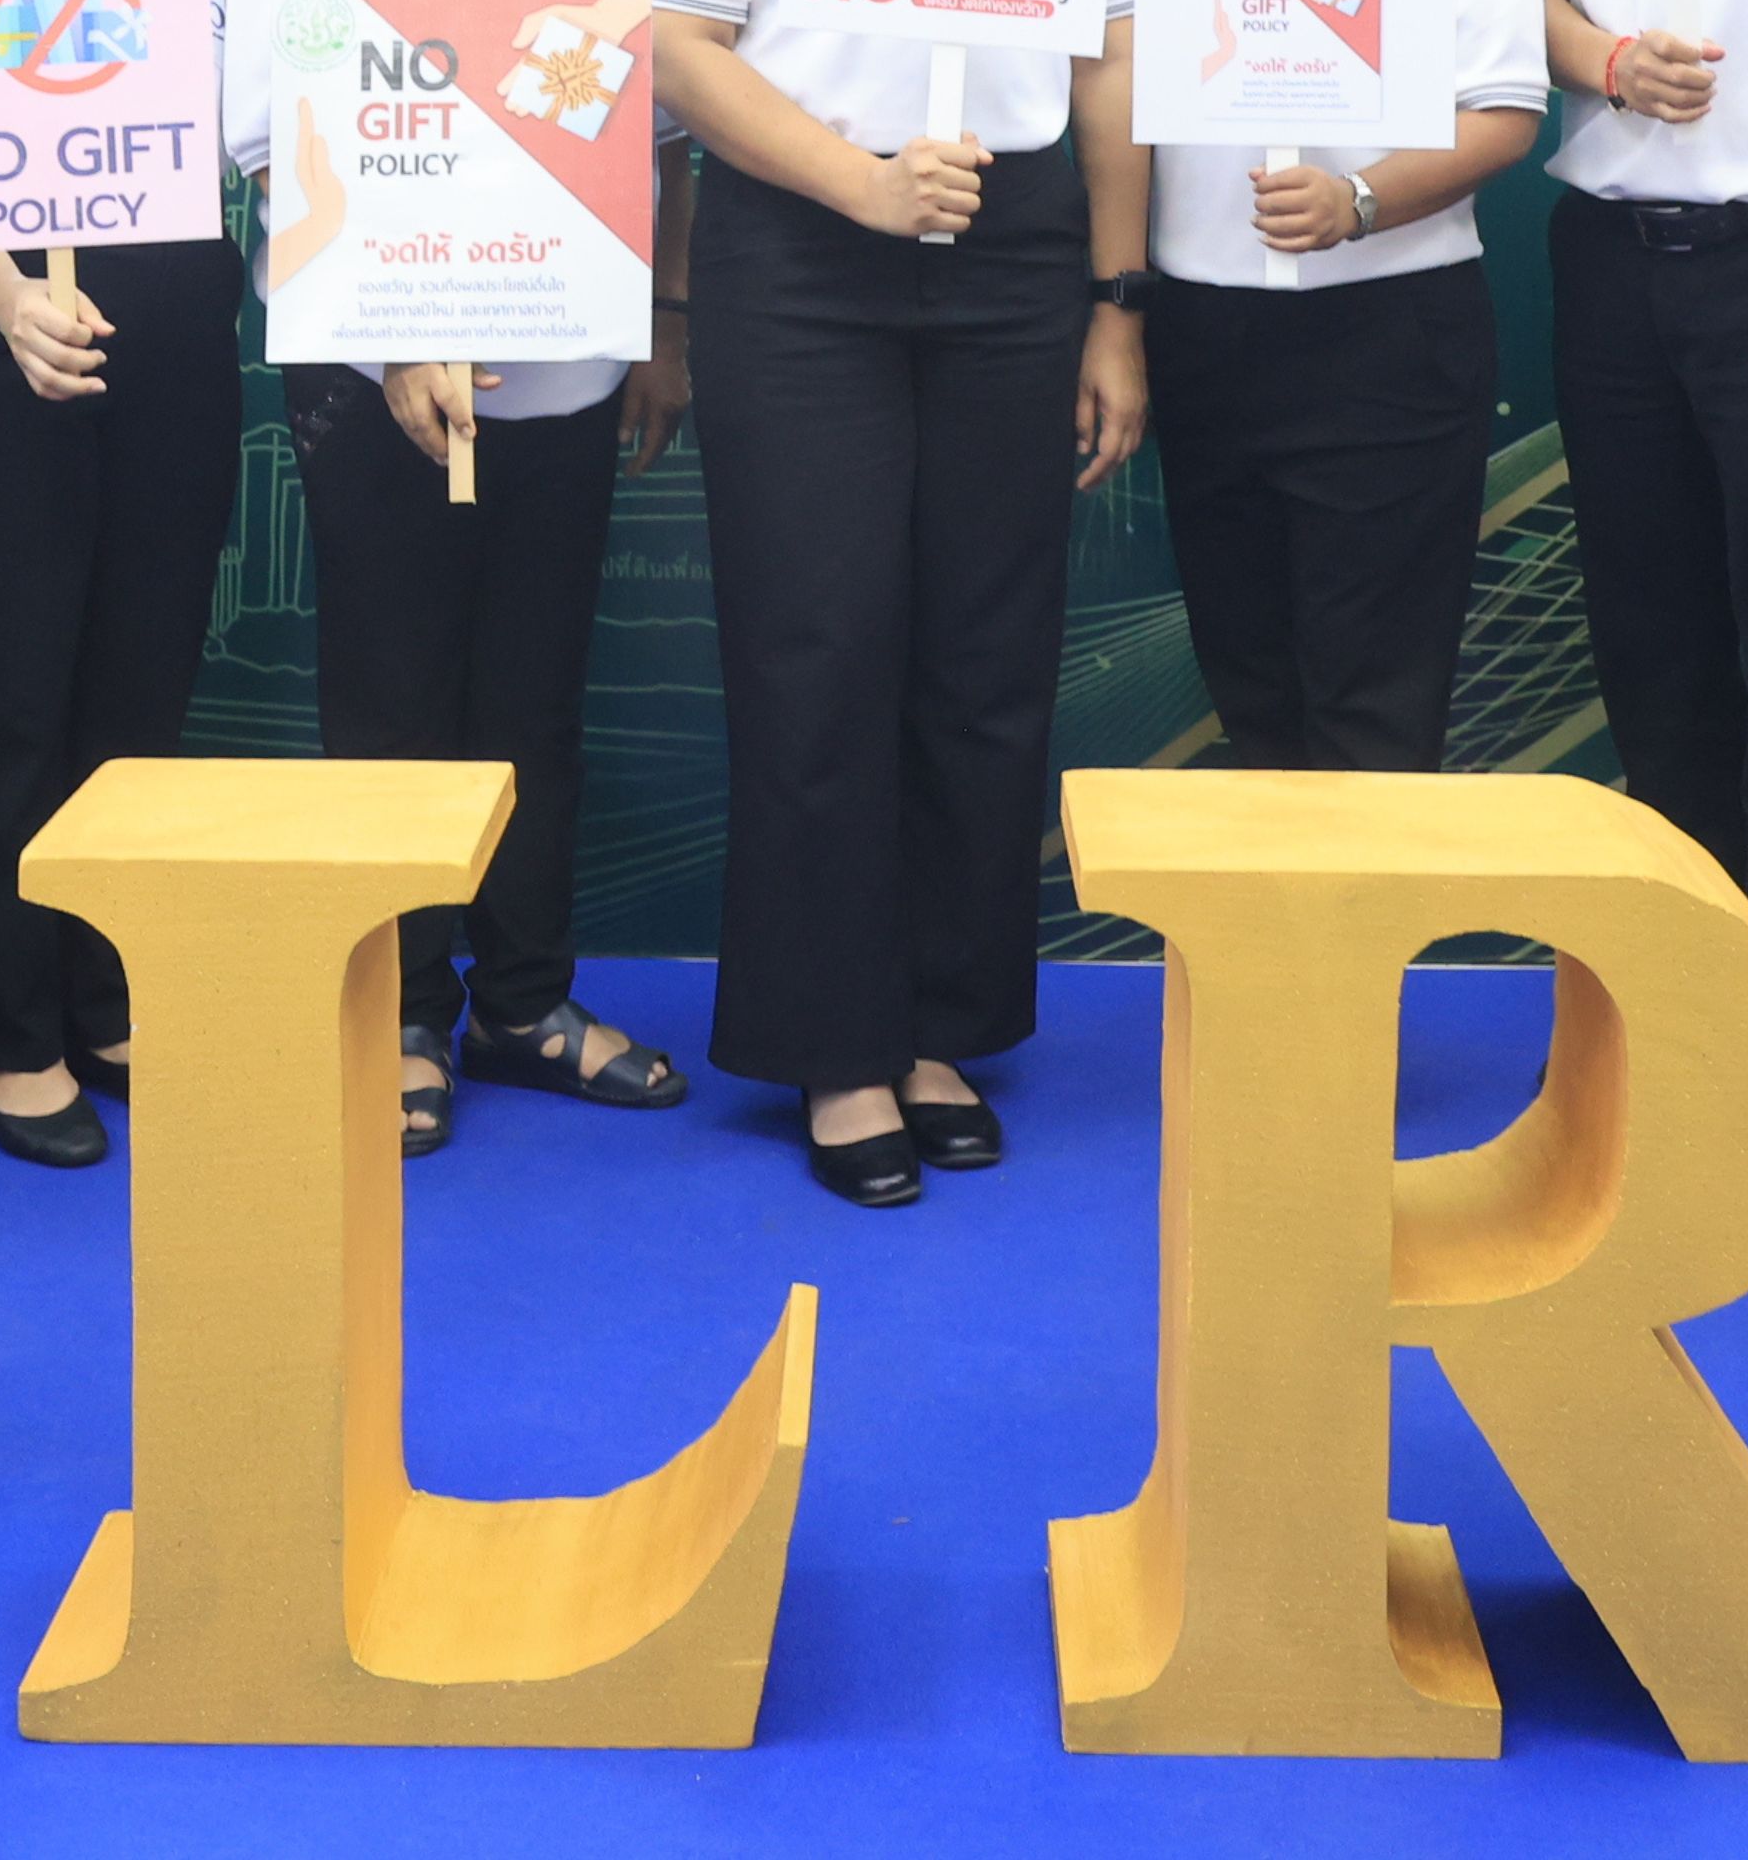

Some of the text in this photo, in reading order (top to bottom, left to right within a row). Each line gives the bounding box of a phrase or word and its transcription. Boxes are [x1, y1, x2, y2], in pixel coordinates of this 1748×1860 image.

[1243, 20, 1289, 32] POLICY
[360, 38, 459, 92] NO
[357, 102, 460, 141] GIFT
[57, 122, 195, 177] GIFT
[359, 153, 459, 177] POLICY
